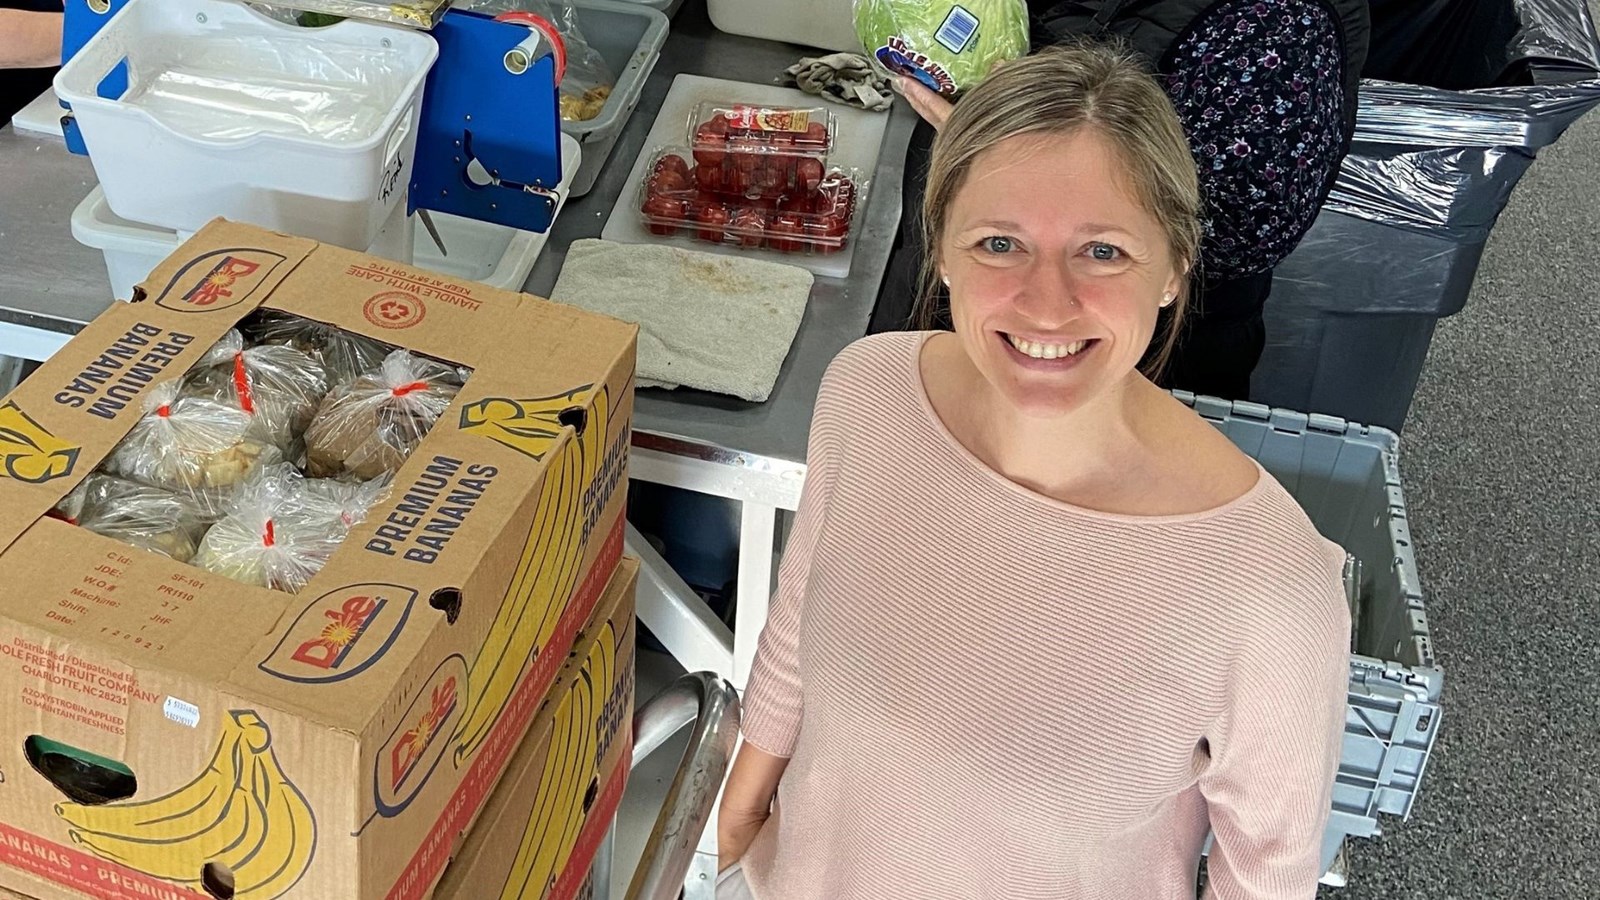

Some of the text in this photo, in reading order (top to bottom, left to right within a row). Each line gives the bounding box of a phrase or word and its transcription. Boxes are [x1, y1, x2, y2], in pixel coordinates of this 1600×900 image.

[188, 257, 260, 305] Dole
[345, 267, 480, 312] HANDLE WITH CARE
[391, 269, 407, 278] OR
[444, 284, 472, 296] KEEP
[54, 323, 163, 408] BANANAS
[87, 332, 195, 420] PREMIUM
[364, 455, 463, 556] PREMIUM
[403, 464, 498, 564] BANANAS
[94, 564, 194, 602] JDE: PR1110
[171, 573, 205, 590] SF-101
[46, 610, 76, 625] Date:
[58, 600, 90, 615] Shift:
[70, 588, 173, 626] Machine: JHF
[290, 596, 377, 669] Dole
[0, 644, 160, 704] OLE FRESH FRUIT COMPANY
[14, 637, 65, 662] Distributed
[72, 657, 123, 680] Dispatched
[22, 665, 128, 706] CHARLOTTE, NC 28231
[22, 687, 124, 726] AZOXYSTROBIN APPLIED
[22, 696, 125, 735] TO MAINTAIN FRESHNESS
[391, 676, 457, 790] Dole
[477, 711, 518, 778] PREMIUM
[421, 790, 467, 869] BANANAS
